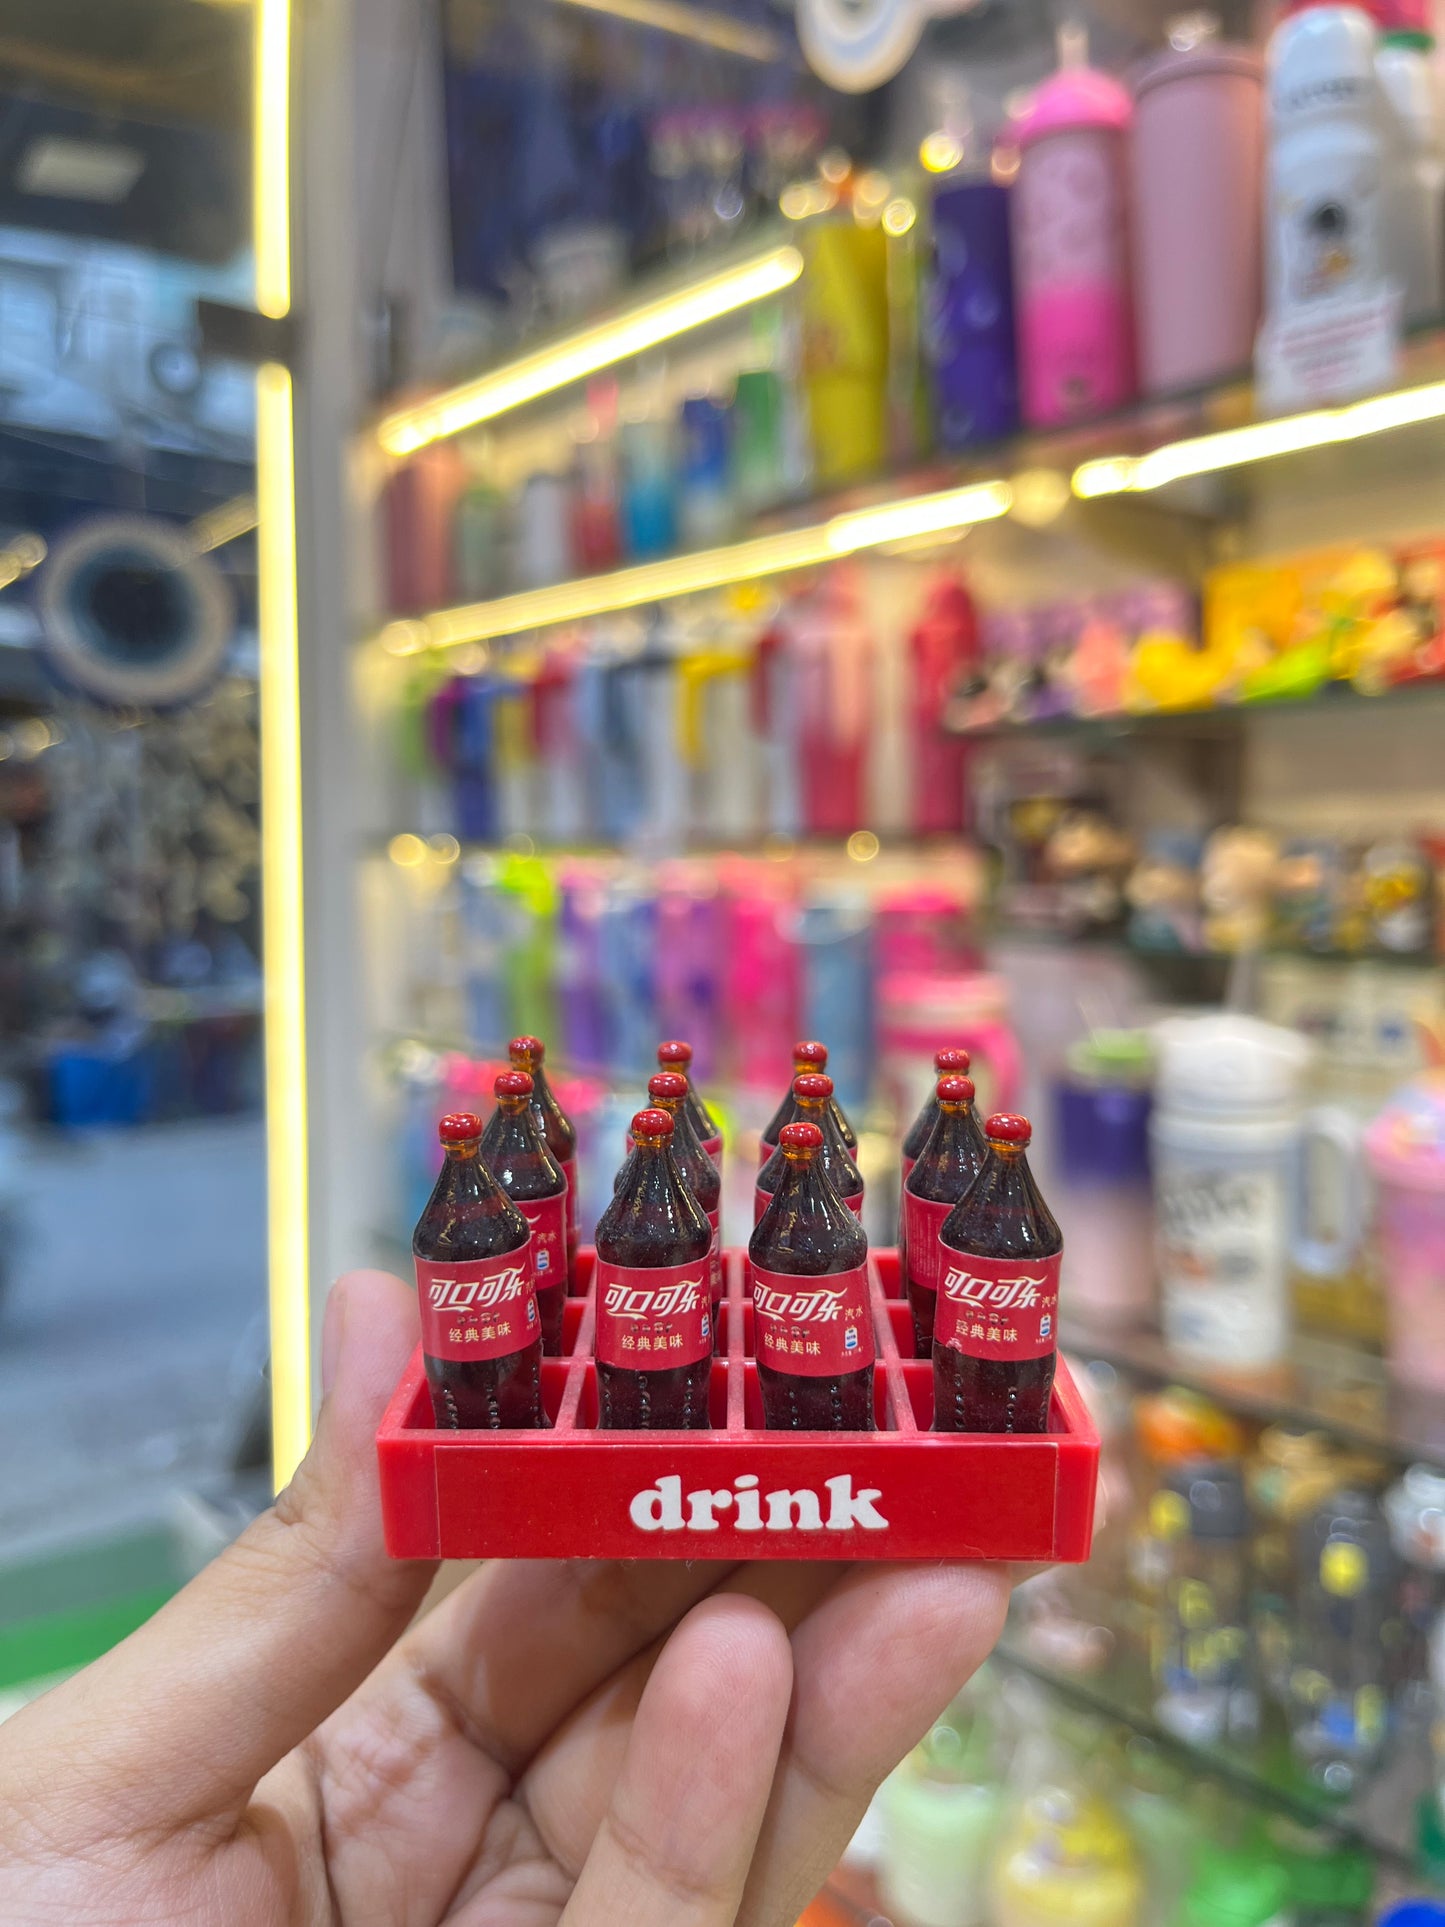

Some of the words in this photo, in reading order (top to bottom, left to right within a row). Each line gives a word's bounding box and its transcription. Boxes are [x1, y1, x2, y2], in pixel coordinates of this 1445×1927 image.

[429, 1262, 526, 1312] 可口可乐
[605, 1276, 704, 1320] 可口可乐
[753, 1280, 848, 1323] 可口可乐
[944, 1266, 1048, 1309] 可口可乐
[449, 1321, 512, 1343] 经典美味
[621, 1332, 684, 1351] 经典美味
[764, 1332, 822, 1356] 经典美味
[956, 1319, 1018, 1343] 经典美味
[629, 1474, 889, 1531] drink
